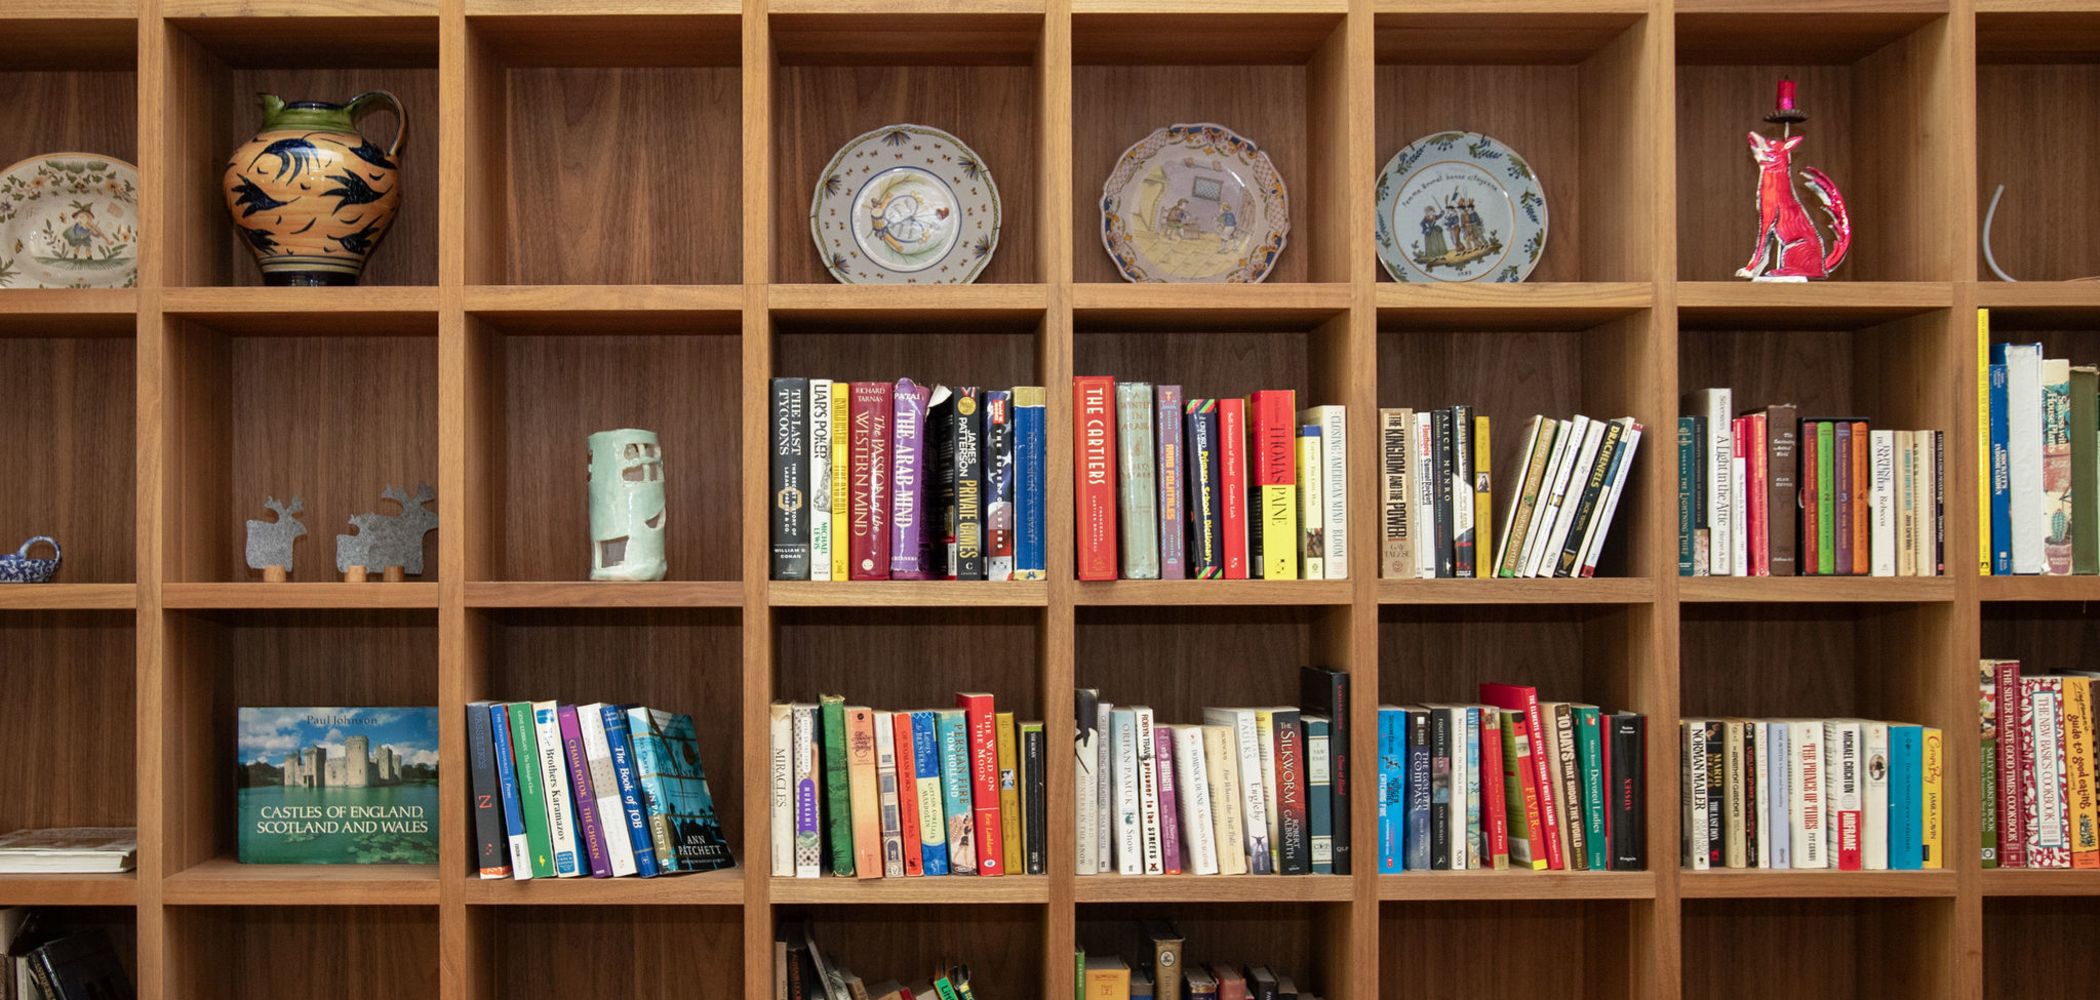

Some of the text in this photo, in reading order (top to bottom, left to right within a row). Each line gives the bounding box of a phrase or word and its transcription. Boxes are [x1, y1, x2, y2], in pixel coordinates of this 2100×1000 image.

[779, 389, 789, 455] TYCOONS
[791, 390, 801, 455] THE LAST
[814, 385, 828, 458] LIAR'S POKER
[1719, 395, 1727, 430] Silverstein
[2047, 393, 2058, 453] House Plants
[959, 417, 968, 476] PATTERSON
[967, 430, 976, 464] JAMES
[1086, 388, 1105, 484] THE CARTIERS
[854, 411, 869, 535] WESTERN MIND
[894, 410, 915, 527] THE ARAB MIND
[1270, 424, 1287, 525] THOMAS PAINE
[1331, 416, 1343, 523] CLOSING AMERICAN MIND
[1385, 416, 1407, 537] THE KINGDOM AND THE POWER
[1590, 425, 1620, 488] DRACHENFELS
[1716, 446, 1730, 471] Light
[1883, 445, 1891, 482] DAPHNE
[1165, 444, 1176, 520] ARAB FOLKTALES
[1717, 473, 1729, 481] in
[1717, 483, 1729, 500] the
[959, 480, 978, 558] PRIVATE GAMES
[1200, 451, 1212, 562] Primary School Dictionary
[1679, 492, 1690, 532] LIGHTNING
[1717, 501, 1729, 525] Attic
[1879, 496, 1888, 526] Rebecca
[792, 526, 797, 535] OF
[1333, 529, 1343, 557] BLOOM
[1679, 534, 1690, 555] THIEF
[307, 715, 378, 725] Paul Johnson
[1530, 706, 1540, 731] ELEMENTS
[474, 712, 487, 770] VASSILIKOS
[986, 739, 994, 772] WIND
[1241, 718, 1251, 760] FAULKS
[1534, 739, 1543, 755] STYLE
[1692, 729, 1705, 771] NORMAN
[2002, 669, 2017, 842] THE SILVER PALATE GOOD TIMES COOKBOOK
[2038, 697, 2055, 821] THE NEW BASICS COOKBOOK
[568, 739, 587, 797] CHAIM POTOK
[775, 748, 786, 808] MIRACLES
[947, 731, 958, 798] TOM HOLLAND
[954, 724, 969, 804] PERSIAN FIRE
[977, 749, 986, 781] MOON
[1122, 723, 1133, 805] ORHAN PAMUK
[1143, 762, 1153, 797] prisoner
[1280, 731, 1296, 804] SILKWORM
[1714, 753, 1722, 787] MARIO
[1843, 731, 1854, 793] MICHAEL CRICHTON
[1986, 747, 1994, 772] SALLY
[2067, 714, 2091, 809] guide to good eating
[505, 783, 513, 799] Poems
[545, 748, 557, 788] Brothers
[552, 790, 565, 841] Karamazov
[615, 746, 643, 829] The Book of JOB
[988, 777, 995, 791] ON
[1414, 752, 1422, 812] COMPASS
[1557, 714, 1582, 848] 10 DAYS THAT SHOOK THE WORLD
[1590, 769, 1602, 833] Devoted Ladies
[1693, 772, 1706, 810] MAILER
[1803, 743, 1817, 829] THE PRINCE OF TIDES
[1986, 773, 1994, 807] CLARKE'S
[261, 806, 424, 819] CASTLES OF ENGLAND,
[647, 783, 667, 851] ANN PATCHETT
[1080, 814, 1086, 822] IN
[1146, 800, 1154, 809] to
[1248, 782, 1262, 821] Engleby
[1525, 787, 1540, 827] FEVER
[1710, 801, 1719, 840] THE LAST DON
[1929, 793, 1937, 816] JAMILA
[257, 821, 428, 833] SCOTLAND AND WALES
[583, 807, 600, 859] THE CHOSEN
[686, 835, 706, 844] ANN
[1126, 829, 1135, 854] Snow
[1148, 827, 1157, 859] STREETS
[1284, 810, 1294, 859] GALBRAITH
[1292, 819, 1300, 848] ROBERT
[1843, 813, 1856, 851] AIRFRAME
[678, 844, 722, 856] PATCHETT
